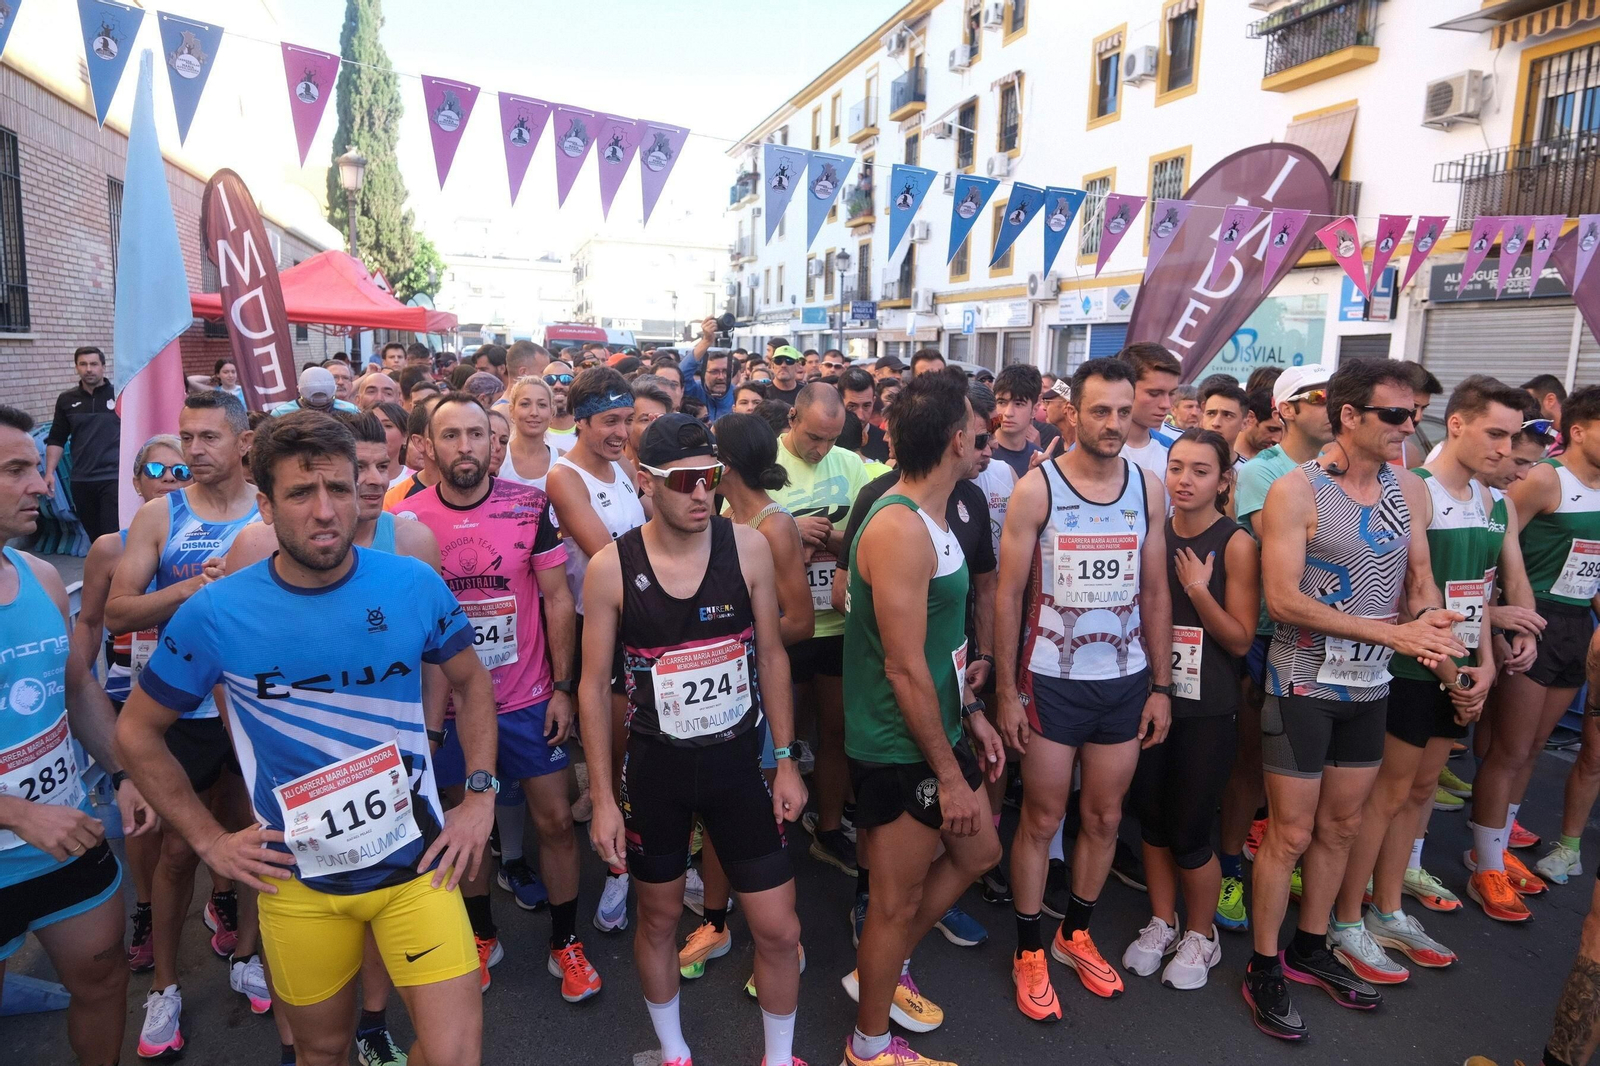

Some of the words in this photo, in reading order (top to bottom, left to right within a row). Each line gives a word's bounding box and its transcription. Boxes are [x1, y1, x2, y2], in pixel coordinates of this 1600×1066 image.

[182, 541, 220, 550] DISMAC
[477, 537, 498, 556] TEAM
[1078, 559, 1120, 580] 189
[666, 655, 692, 665] CARRERA
[677, 662, 700, 670] MEMORIAL
[532, 685, 543, 697] 23
[682, 673, 732, 705] 224
[7, 753, 36, 770] MEMORIAL
[549, 753, 566, 762] adidas
[19, 757, 69, 802] 283
[284, 790, 295, 800] XLI
[295, 777, 326, 795] CARRERA
[308, 784, 337, 799] MEMORIAL
[337, 776, 351, 787] KIKO
[320, 789, 387, 839] 116
